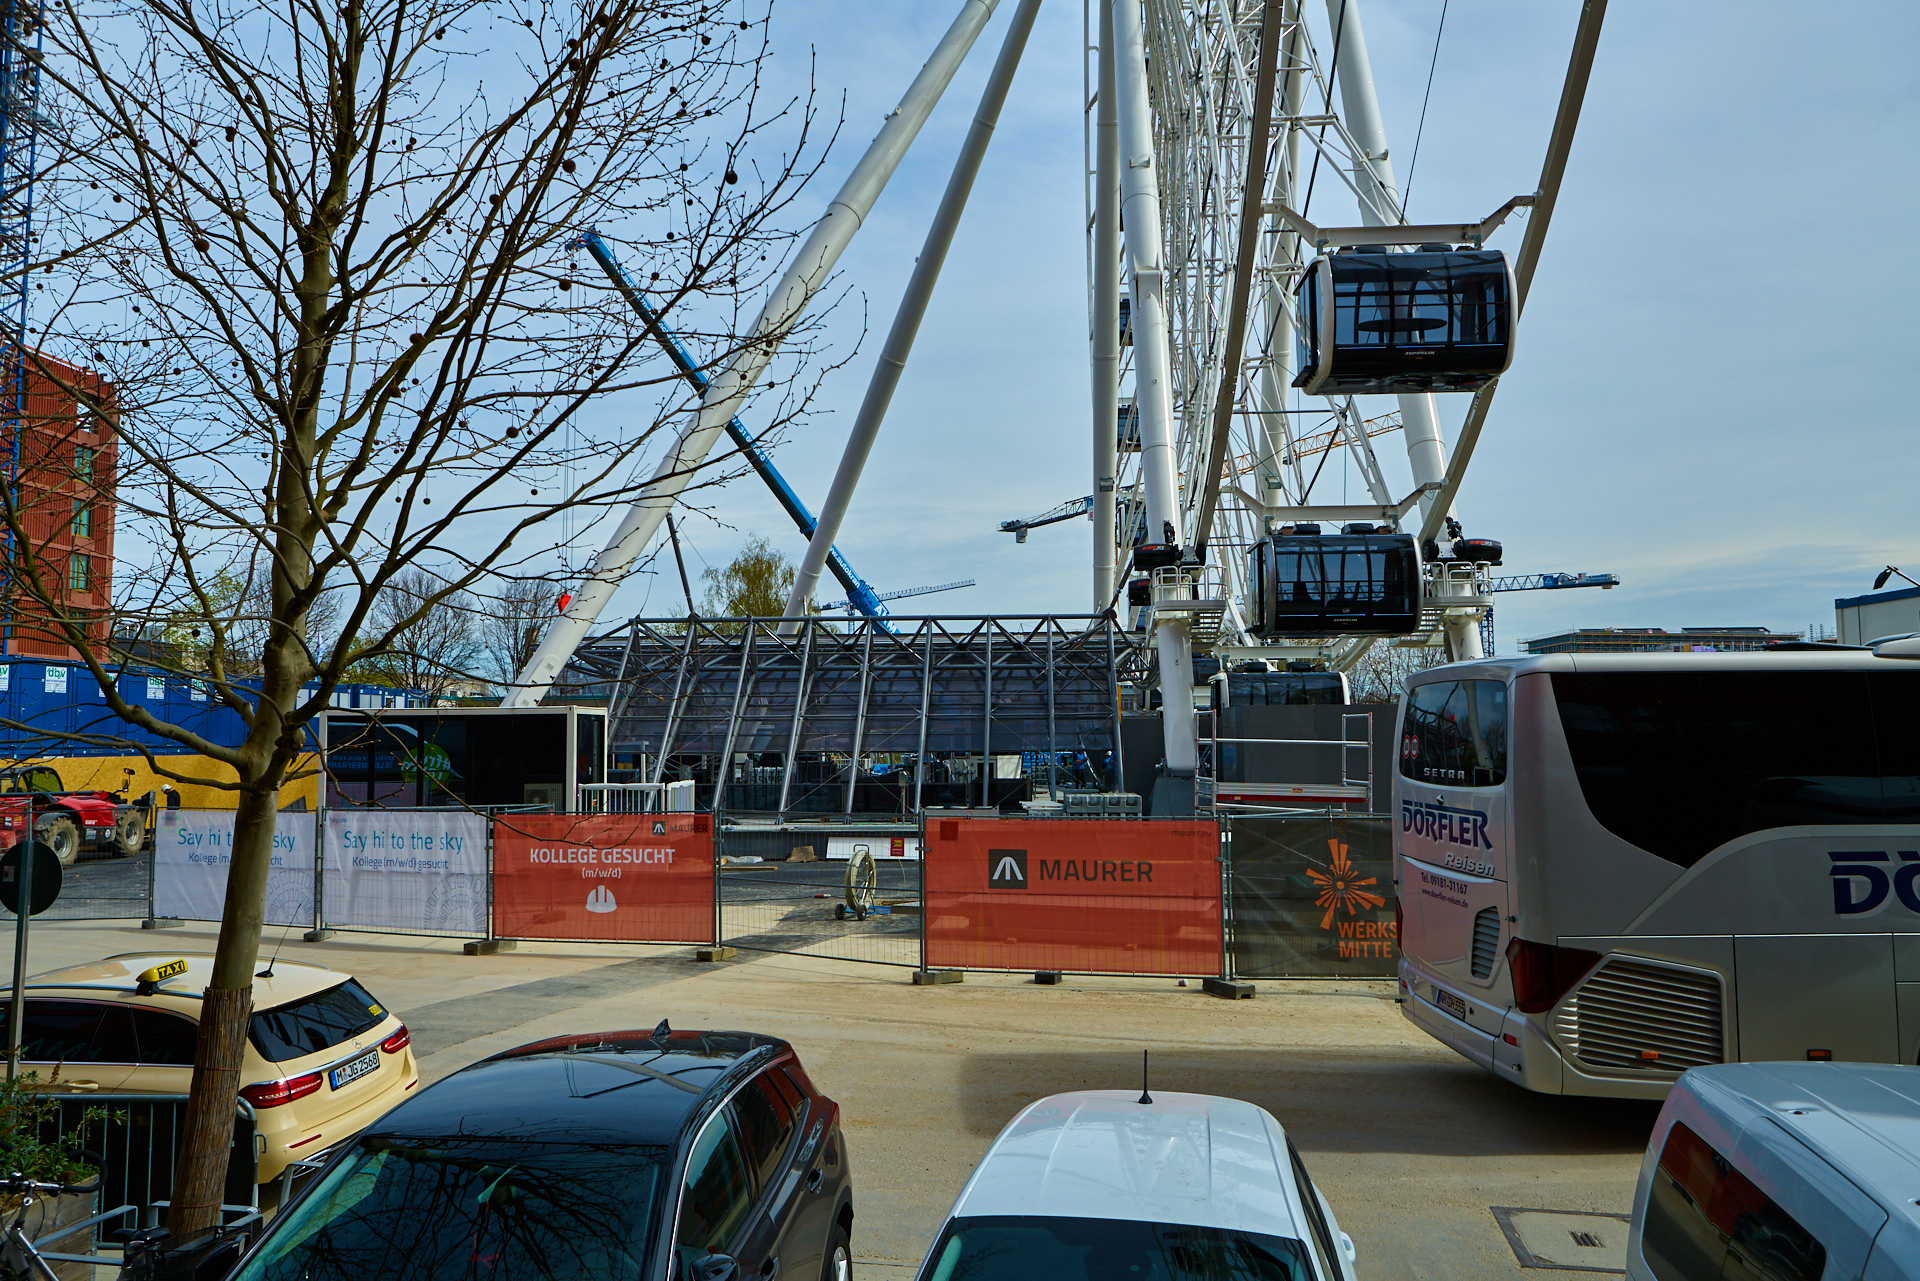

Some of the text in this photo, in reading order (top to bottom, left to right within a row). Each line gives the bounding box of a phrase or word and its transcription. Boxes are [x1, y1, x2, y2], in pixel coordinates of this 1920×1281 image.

[1424, 767, 1465, 779] SETRA
[669, 824, 708, 833] MAURER
[1402, 799, 1494, 851] DÖRFLER
[178, 828, 203, 849] Say
[208, 829, 221, 846] hi
[273, 831, 295, 853] sky
[344, 830, 463, 855] Say hi to the sky
[352, 856, 449, 871] Kollege (m/w/d) gesucht
[530, 848, 675, 864] KOLLEGE GESUCHT
[1445, 851, 1495, 876] Reisen
[582, 867, 621, 879] (m/w/d)
[1040, 859, 1153, 882] MAURER
[1421, 871, 1468, 895] Tel. 09181-31167
[1421, 887, 1469, 909] www.doerfler-reisen.de
[1340, 941, 1393, 958] MITTE
[158, 961, 185, 977] TAXI
[335, 1053, 378, 1083] M JG 2568
